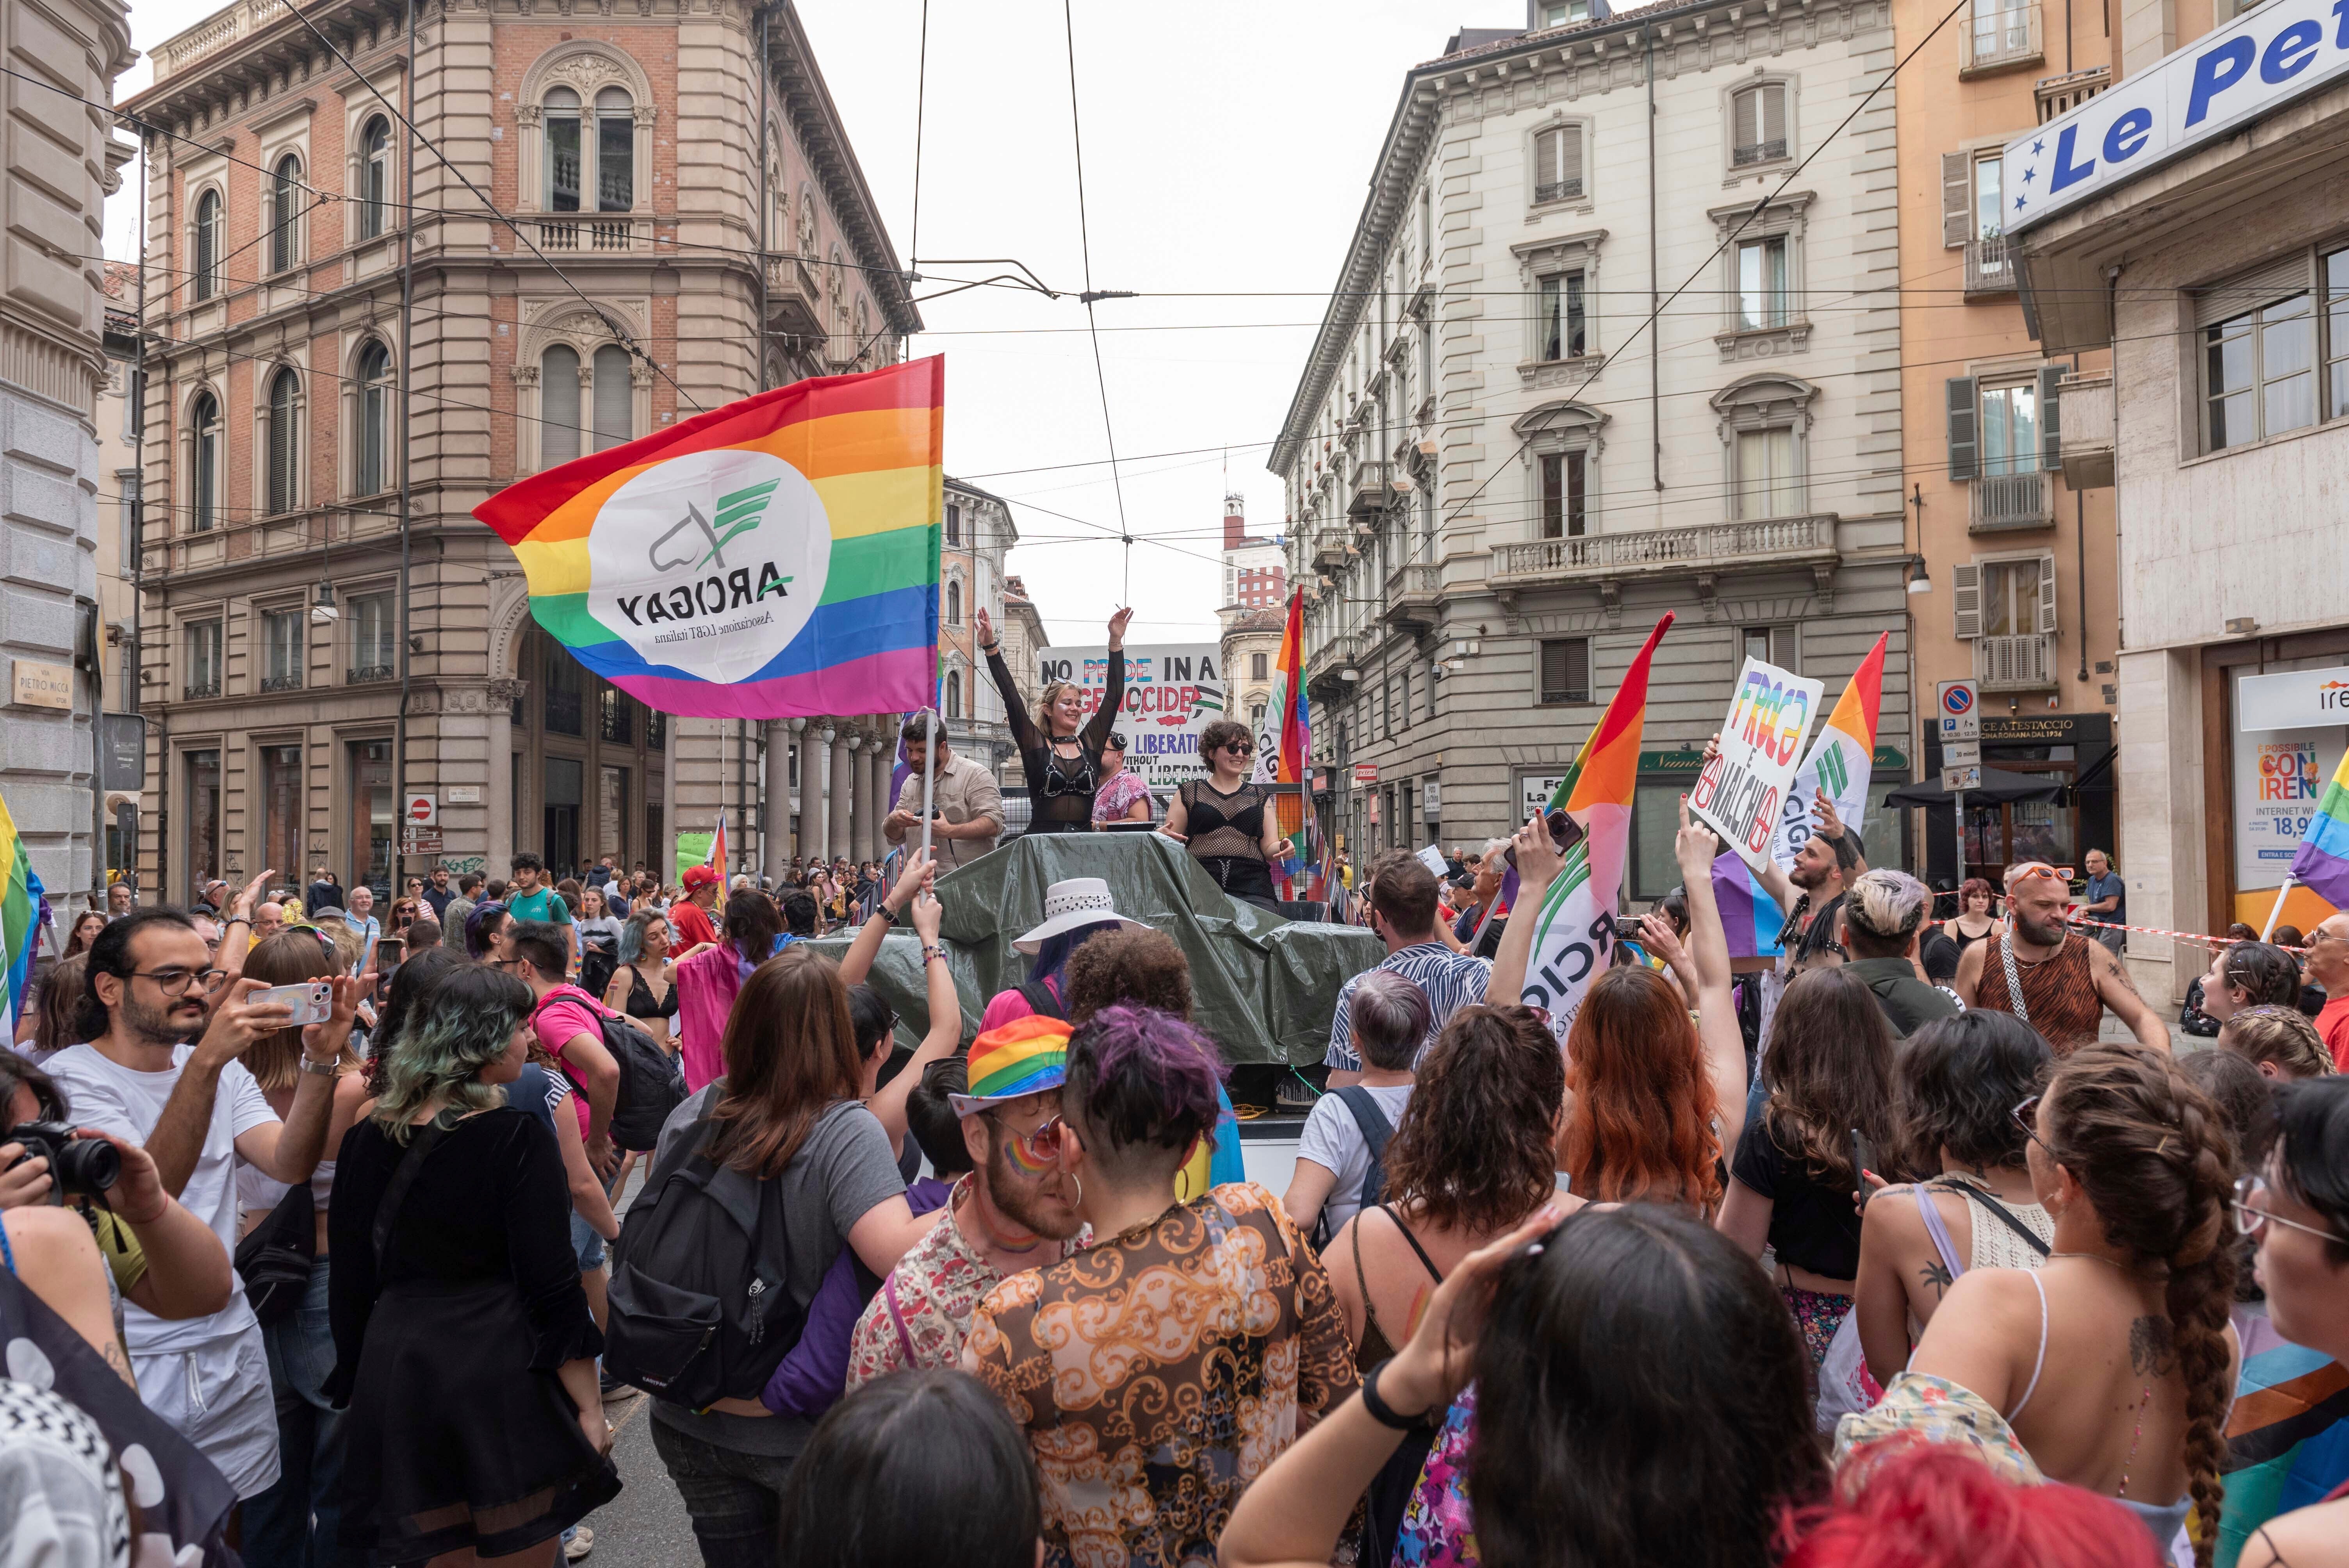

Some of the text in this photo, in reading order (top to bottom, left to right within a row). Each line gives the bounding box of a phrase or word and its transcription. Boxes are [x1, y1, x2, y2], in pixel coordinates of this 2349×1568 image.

[2050, 107, 2152, 195] Le
[1041, 656, 1217, 684] NO PRDE IN A
[21, 677, 69, 693] PIETRO MICCA
[1981, 720, 2073, 731] CE A TESTACCIO
[1135, 734, 1200, 754] LIBERATI
[1258, 722, 1280, 780] CIG
[2265, 742, 2315, 753] POSSIBILE
[2258, 752, 2316, 778] CON
[1527, 792, 1546, 802] La
[2259, 777, 2317, 800] IREN
[2256, 807, 2299, 816] INTERNET
[2273, 817, 2313, 838] 18,9
